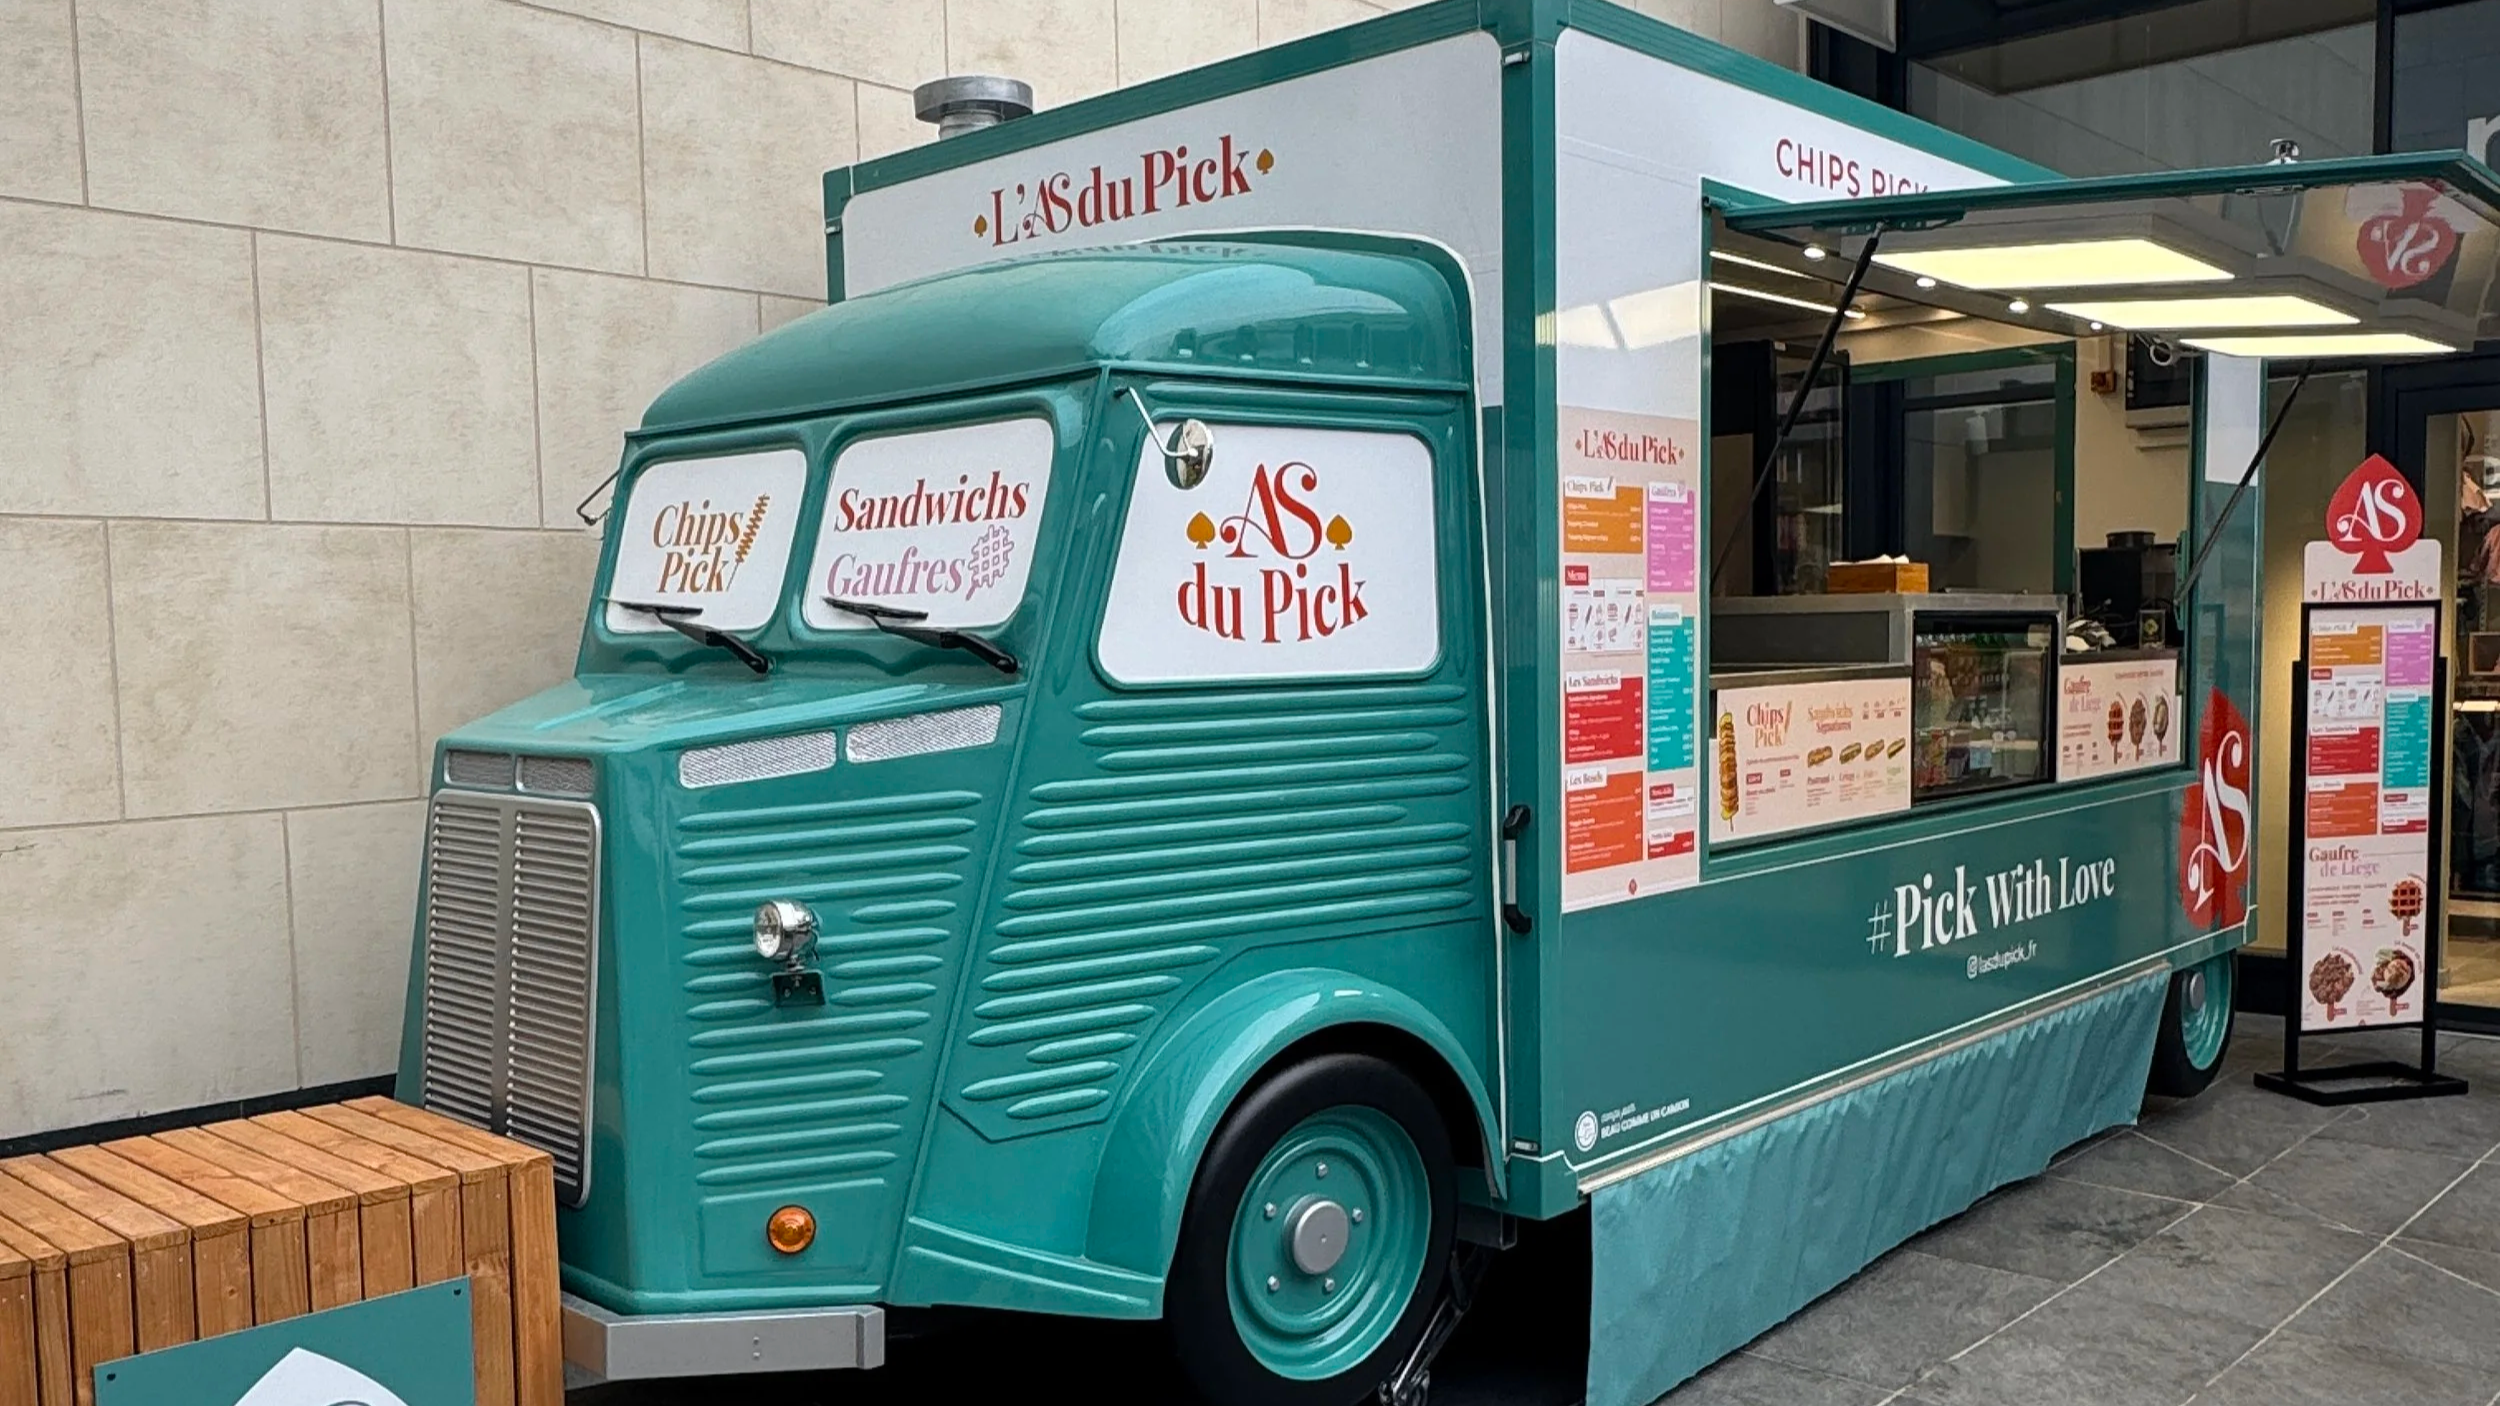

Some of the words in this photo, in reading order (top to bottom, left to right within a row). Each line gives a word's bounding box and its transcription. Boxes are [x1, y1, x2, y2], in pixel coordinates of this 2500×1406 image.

[1776, 138, 1861, 198] CHIPS
[652, 499, 743, 556] Chips
[833, 470, 1030, 533] Sandwichs
[1219, 461, 1323, 560] AS
[2336, 478, 2407, 542] AS
[655, 546, 730, 594] Pick
[826, 545, 967, 598] Gaufres
[1177, 561, 1246, 642] du
[1258, 562, 1369, 644] Pick
[1746, 701, 1784, 729] Chips
[1754, 724, 1783, 749] Pick
[2308, 844, 2360, 863] Gaufre
[2320, 861, 2336, 878] de
[1866, 864, 1978, 959] #Pick
[1984, 858, 2052, 931] With
[2059, 855, 2117, 911] Love
